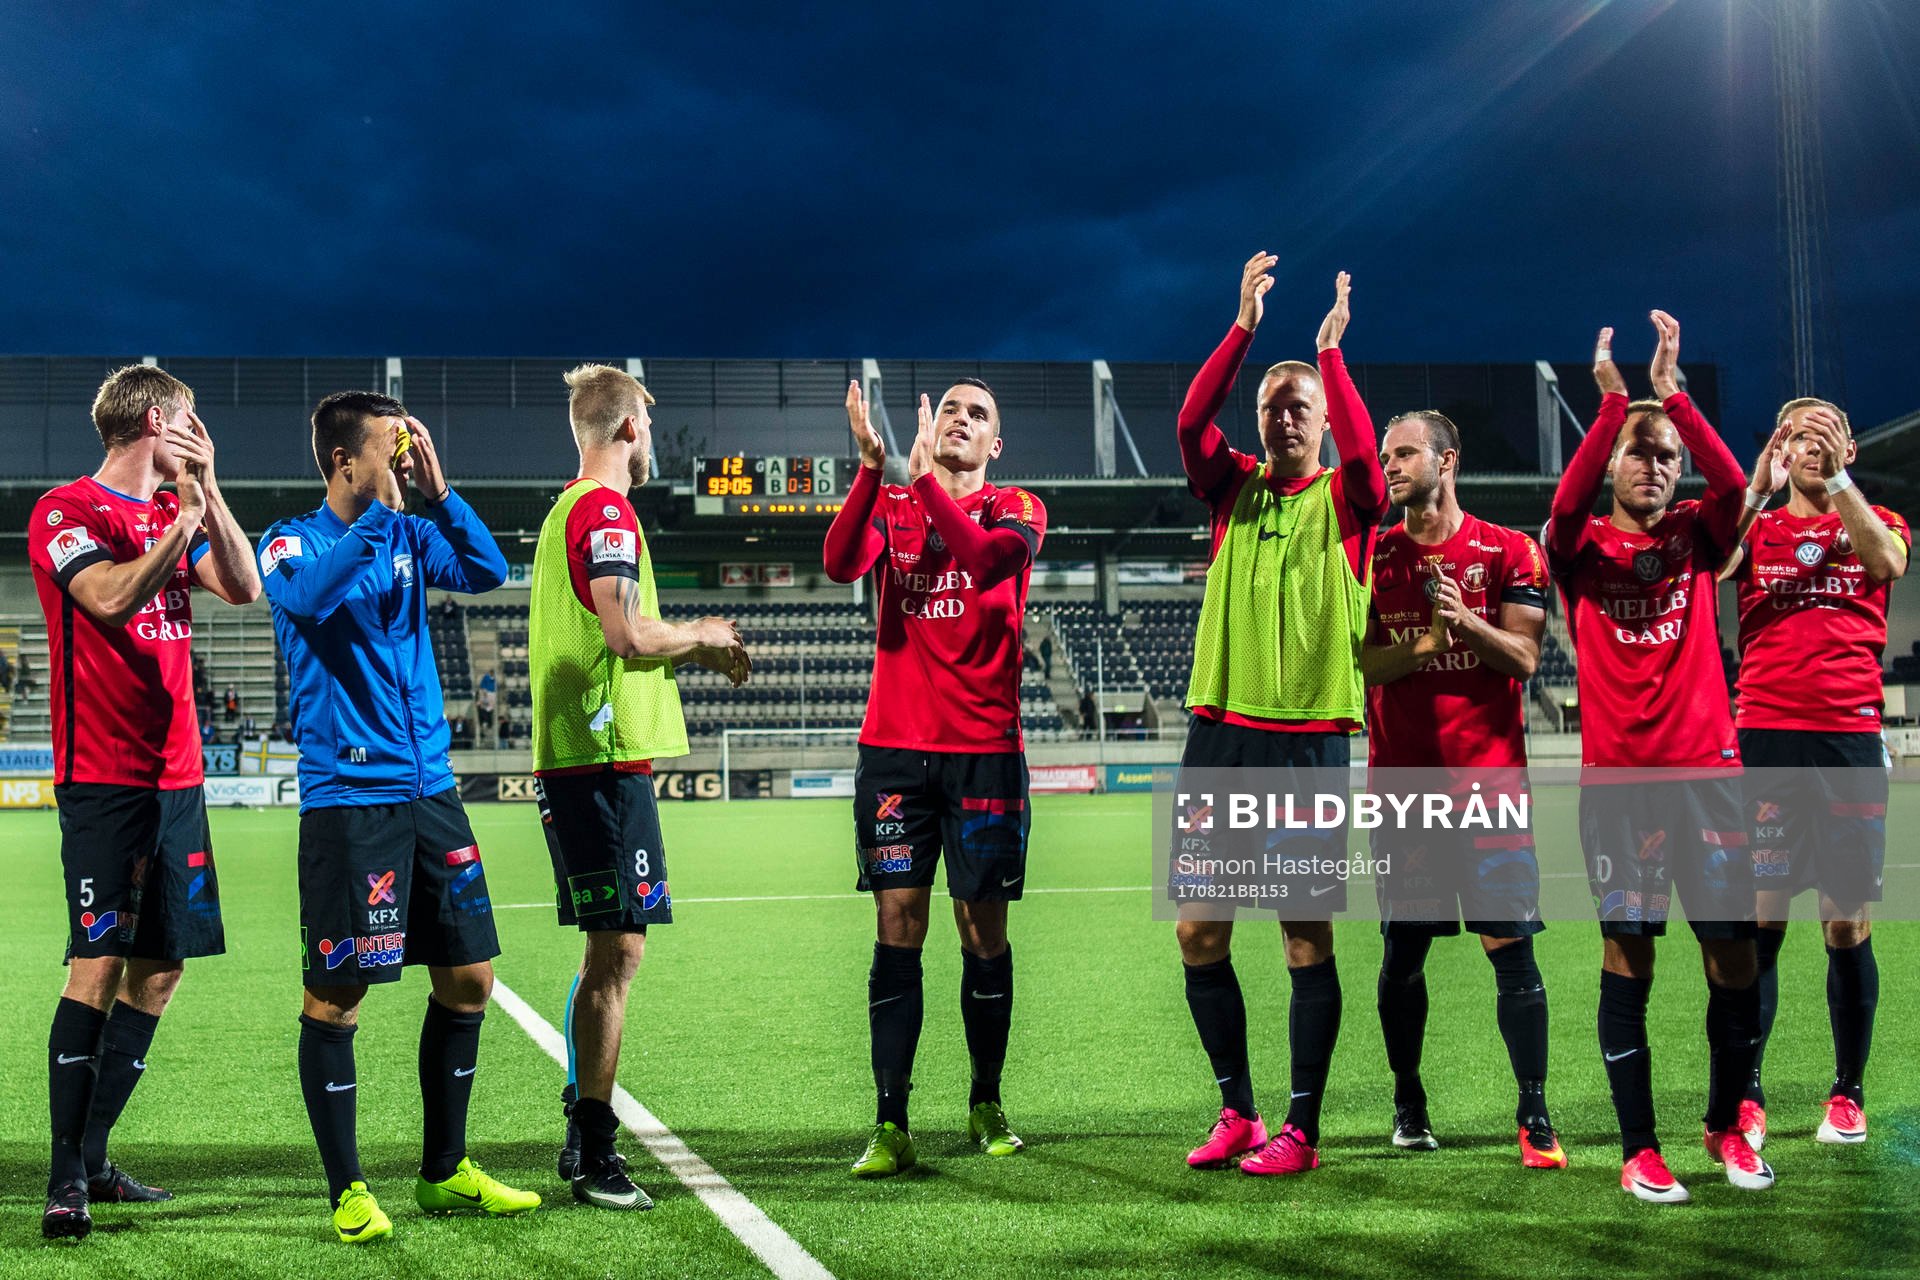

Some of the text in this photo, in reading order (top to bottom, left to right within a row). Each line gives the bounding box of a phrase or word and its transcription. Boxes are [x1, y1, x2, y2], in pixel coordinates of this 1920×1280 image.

[771, 460, 782, 474] A
[818, 460, 829, 474] C
[708, 477, 752, 495] 93:05
[771, 479, 782, 493] B
[818, 479, 830, 493] D
[1758, 576, 1861, 596] MELLBY
[901, 596, 965, 619] GÅRD
[1600, 588, 1691, 620] MELLB
[351, 747, 367, 762] M
[3, 782, 40, 804] NP3
[211, 783, 265, 797] ViaCon
[875, 823, 905, 836] KFX
[1756, 826, 1785, 838] KFX
[1181, 838, 1211, 851] KFX
[635, 849, 650, 877] 8
[1751, 849, 1790, 864] NTER
[871, 858, 912, 875] SPORT
[80, 878, 95, 908] 5
[368, 907, 399, 925] KFX
[356, 932, 404, 954] INTER
[358, 948, 404, 969] SPORT
